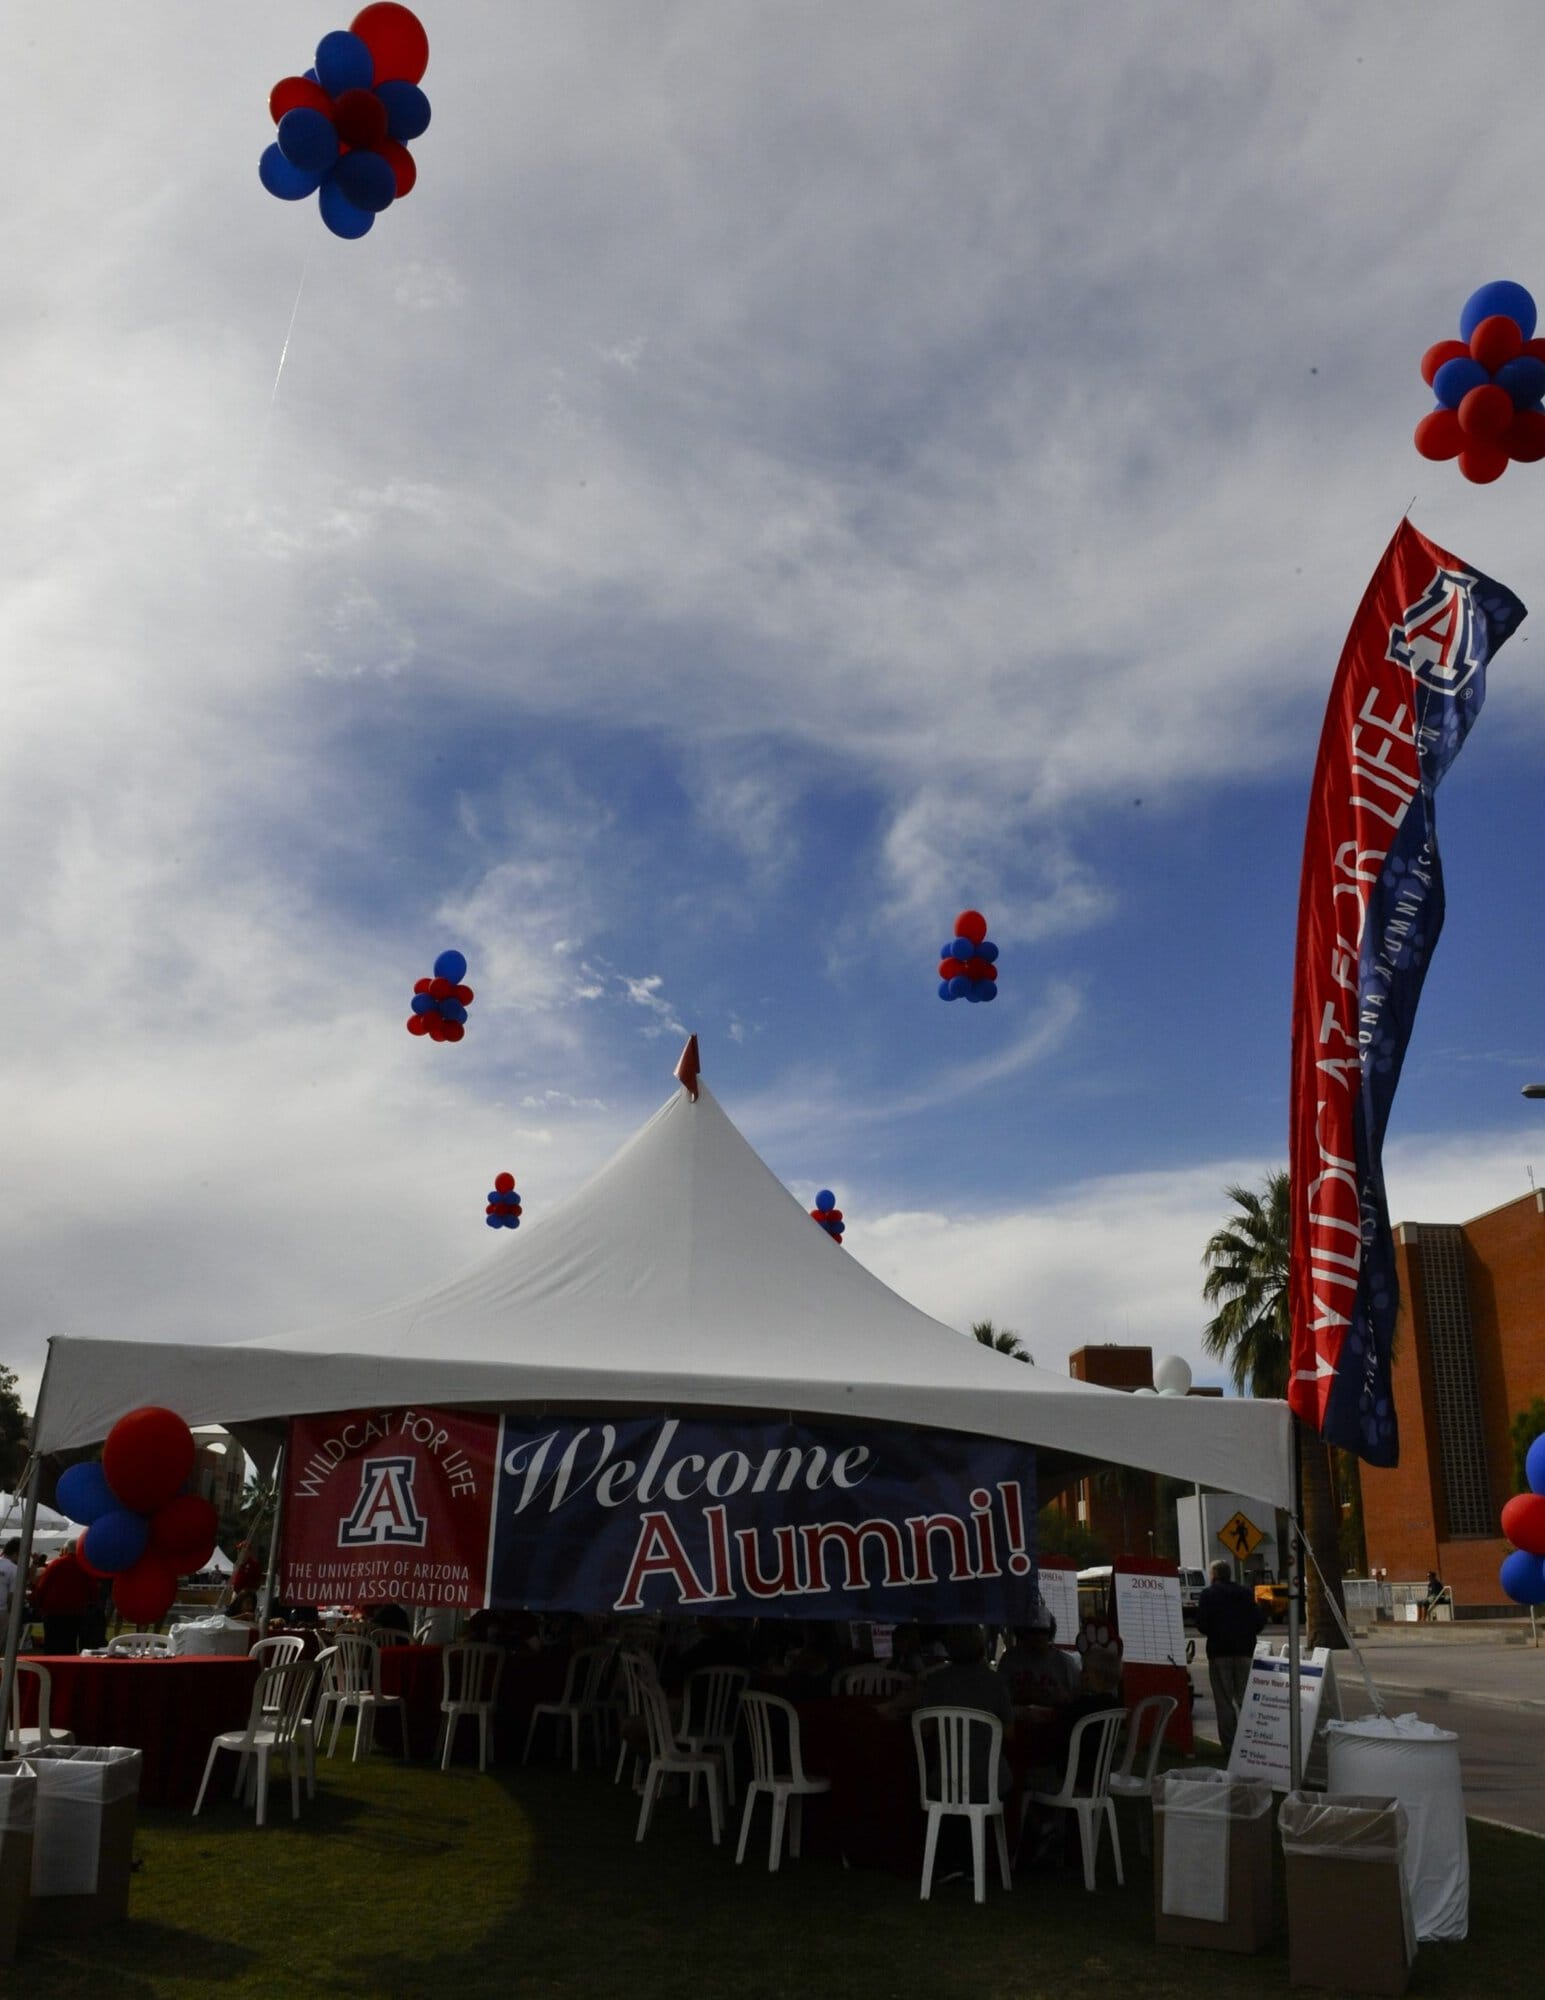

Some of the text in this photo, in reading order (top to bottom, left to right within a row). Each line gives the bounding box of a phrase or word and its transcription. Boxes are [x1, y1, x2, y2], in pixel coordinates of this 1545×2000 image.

[1349, 686, 1421, 831] LIFE
[1373, 890, 1423, 981] ALUMNI
[295, 1410, 476, 1498] WILDCAT FOR LIFE
[504, 1419, 880, 1514] Welcome
[337, 1456, 428, 1547] A
[613, 1481, 1031, 1611] Alumni!
[285, 1580, 468, 1603] ALUMNI ASSOCIATION
[288, 1560, 469, 1581] THE UNIVERSITY OF ARIZONA
[1131, 1577, 1164, 1591] 2000s
